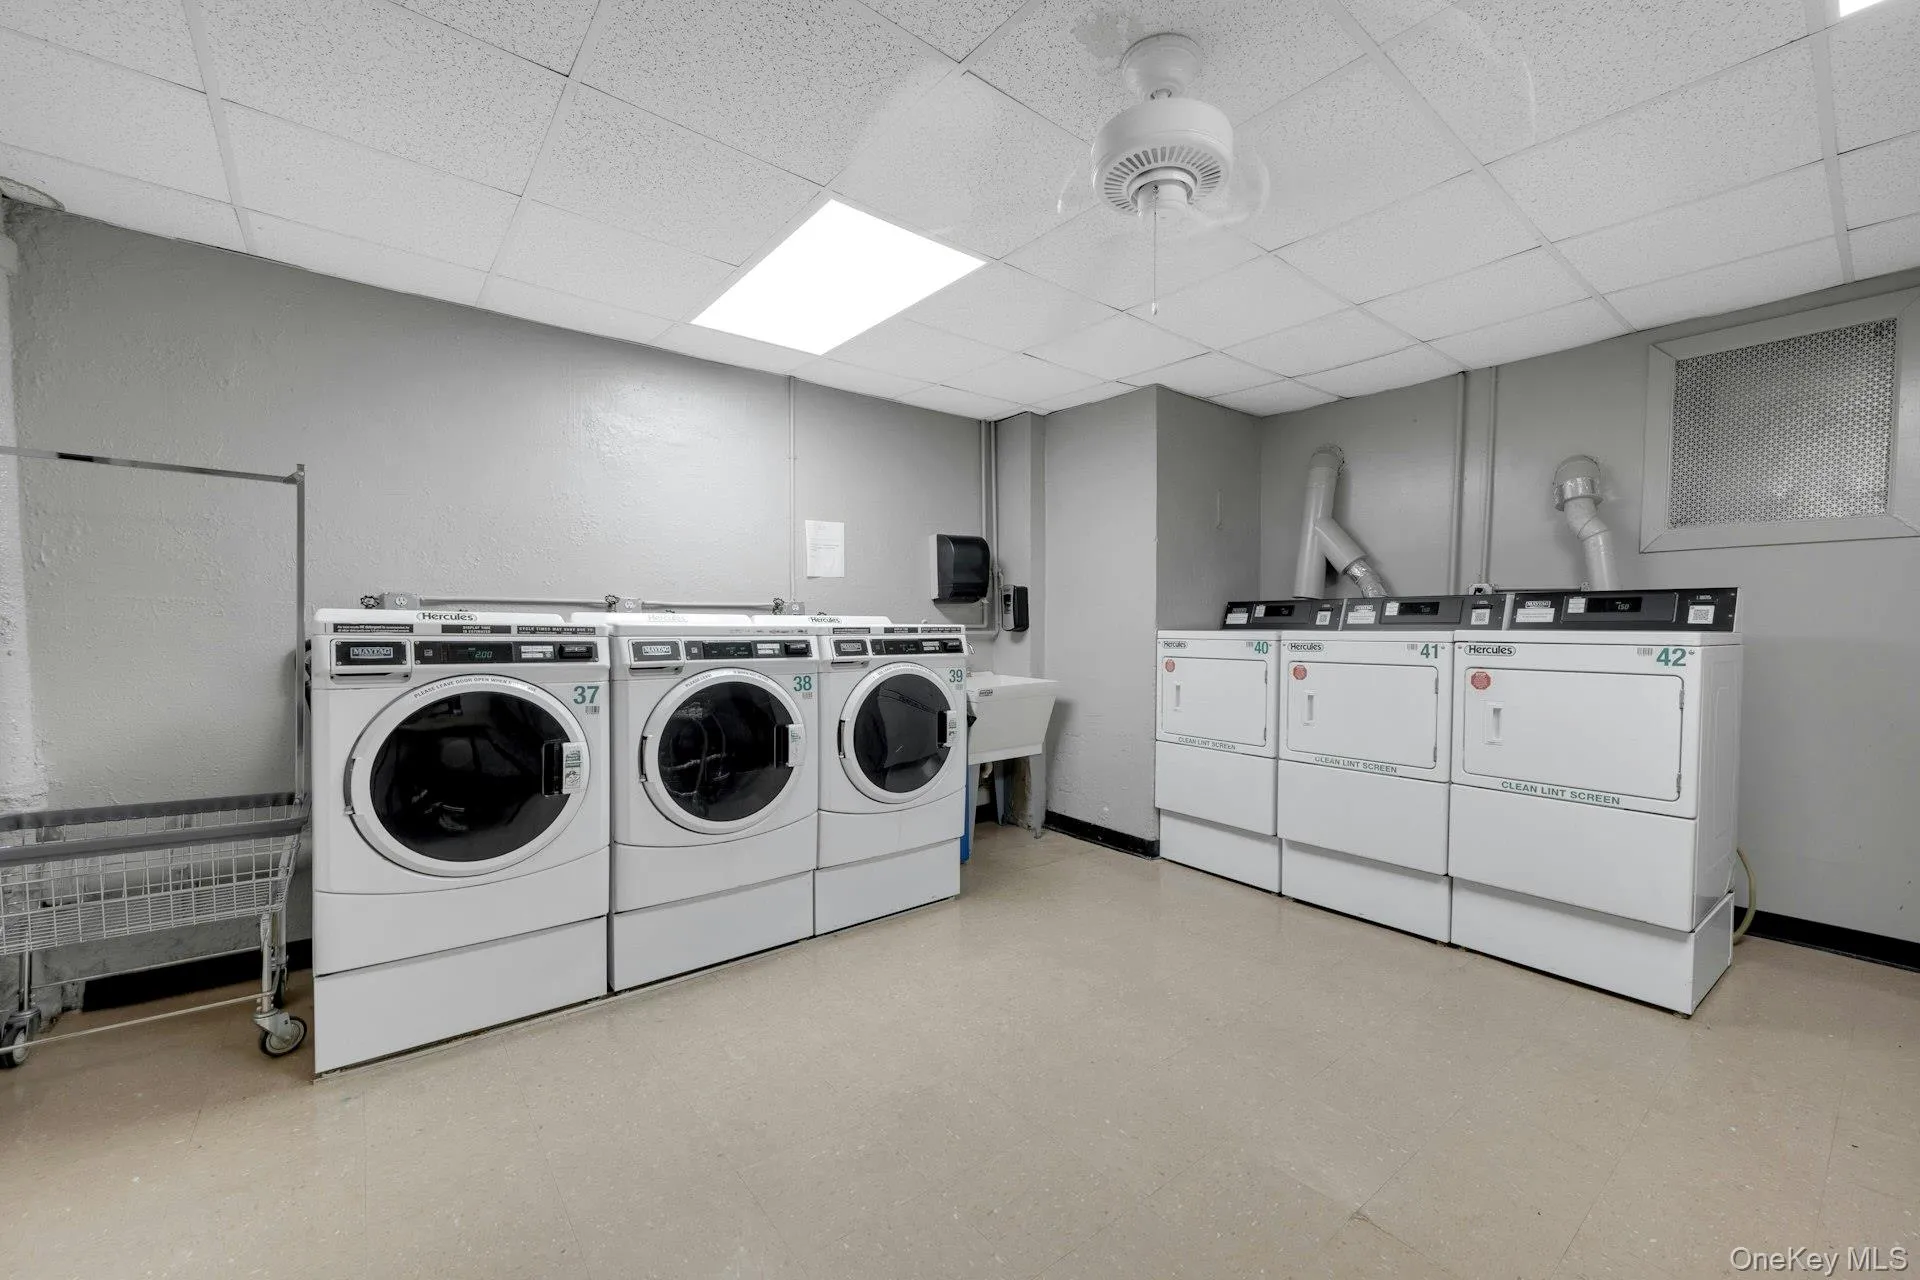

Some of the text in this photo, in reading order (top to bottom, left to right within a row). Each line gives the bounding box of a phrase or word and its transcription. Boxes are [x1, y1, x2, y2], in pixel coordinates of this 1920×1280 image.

[422, 612, 474, 622] Hercules
[353, 647, 392, 657] MAYTAG
[1254, 641, 1268, 655] 40
[1290, 643, 1322, 651] Hercules
[1420, 643, 1438, 659] 41
[1468, 645, 1513, 655] Hercules
[1656, 647, 1687, 667] 42
[793, 675, 812, 692] 38
[949, 669, 963, 683] 39
[413, 687, 436, 699] PLEASE
[435, 681, 455, 691] LEAVE
[455, 677, 473, 685] DOOR
[573, 685, 600, 705] 37
[1178, 736, 1197, 745] CLEAN
[1211, 742, 1236, 750] SCREEN
[1315, 756, 1397, 774] CLEAN LINT SCREEN
[1501, 780, 1621, 806] CLEAN LINT SCREEN
